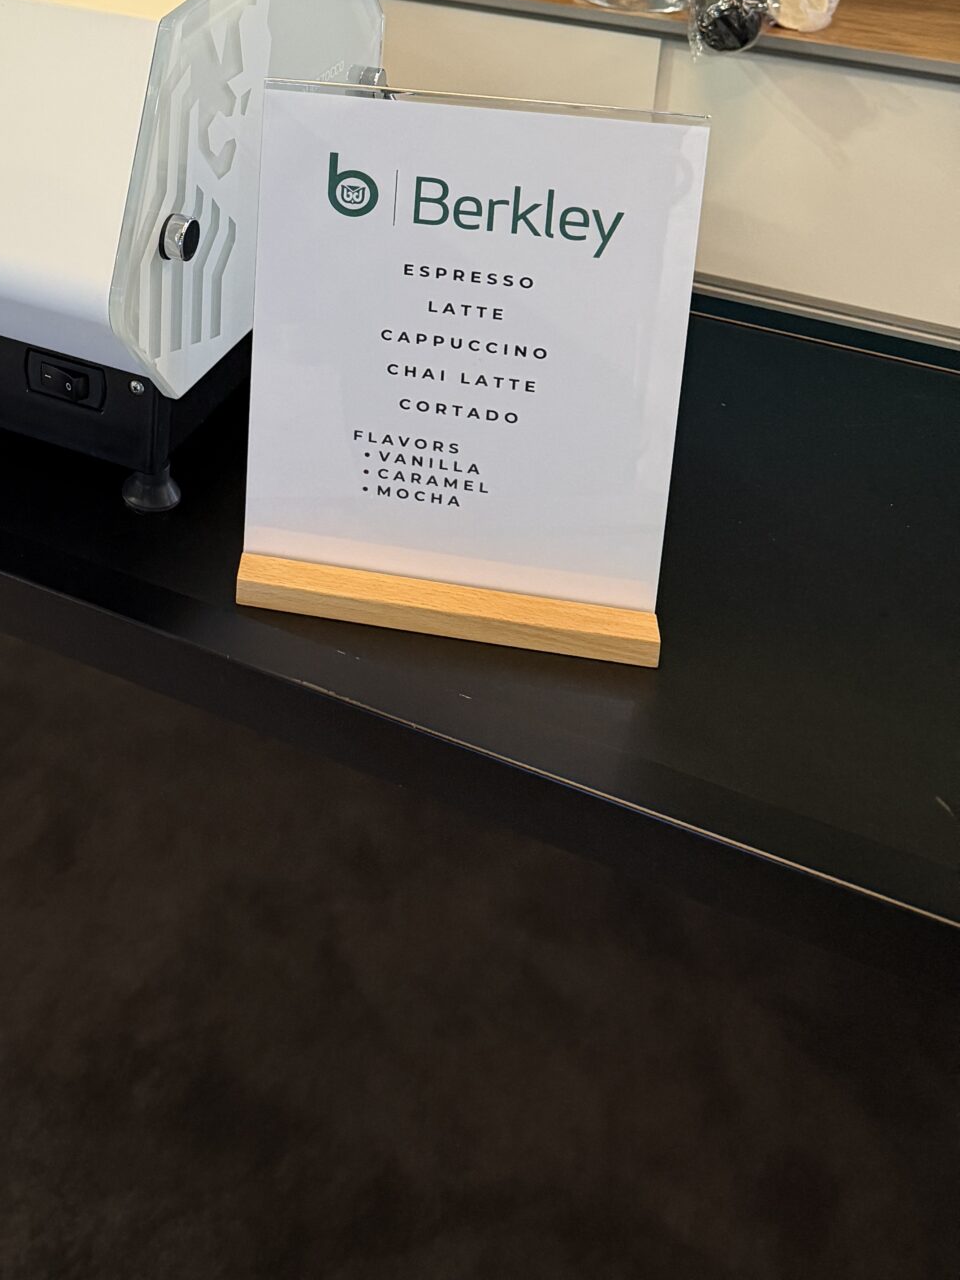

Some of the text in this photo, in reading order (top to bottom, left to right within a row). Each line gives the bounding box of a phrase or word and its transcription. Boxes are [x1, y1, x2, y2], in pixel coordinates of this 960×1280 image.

[413, 176, 625, 259] Berkley
[403, 263, 534, 289] ESPRESSO
[428, 300, 504, 321] LATTE
[380, 329, 548, 360] CAPPUCCINO
[386, 363, 536, 393] CHAI LATTE
[399, 398, 519, 424] CORTADO
[353, 429, 460, 454] FLAVORS
[378, 450, 480, 475] VANILLA
[377, 468, 489, 494] CARAMEL
[377, 485, 460, 508] MOCHA
